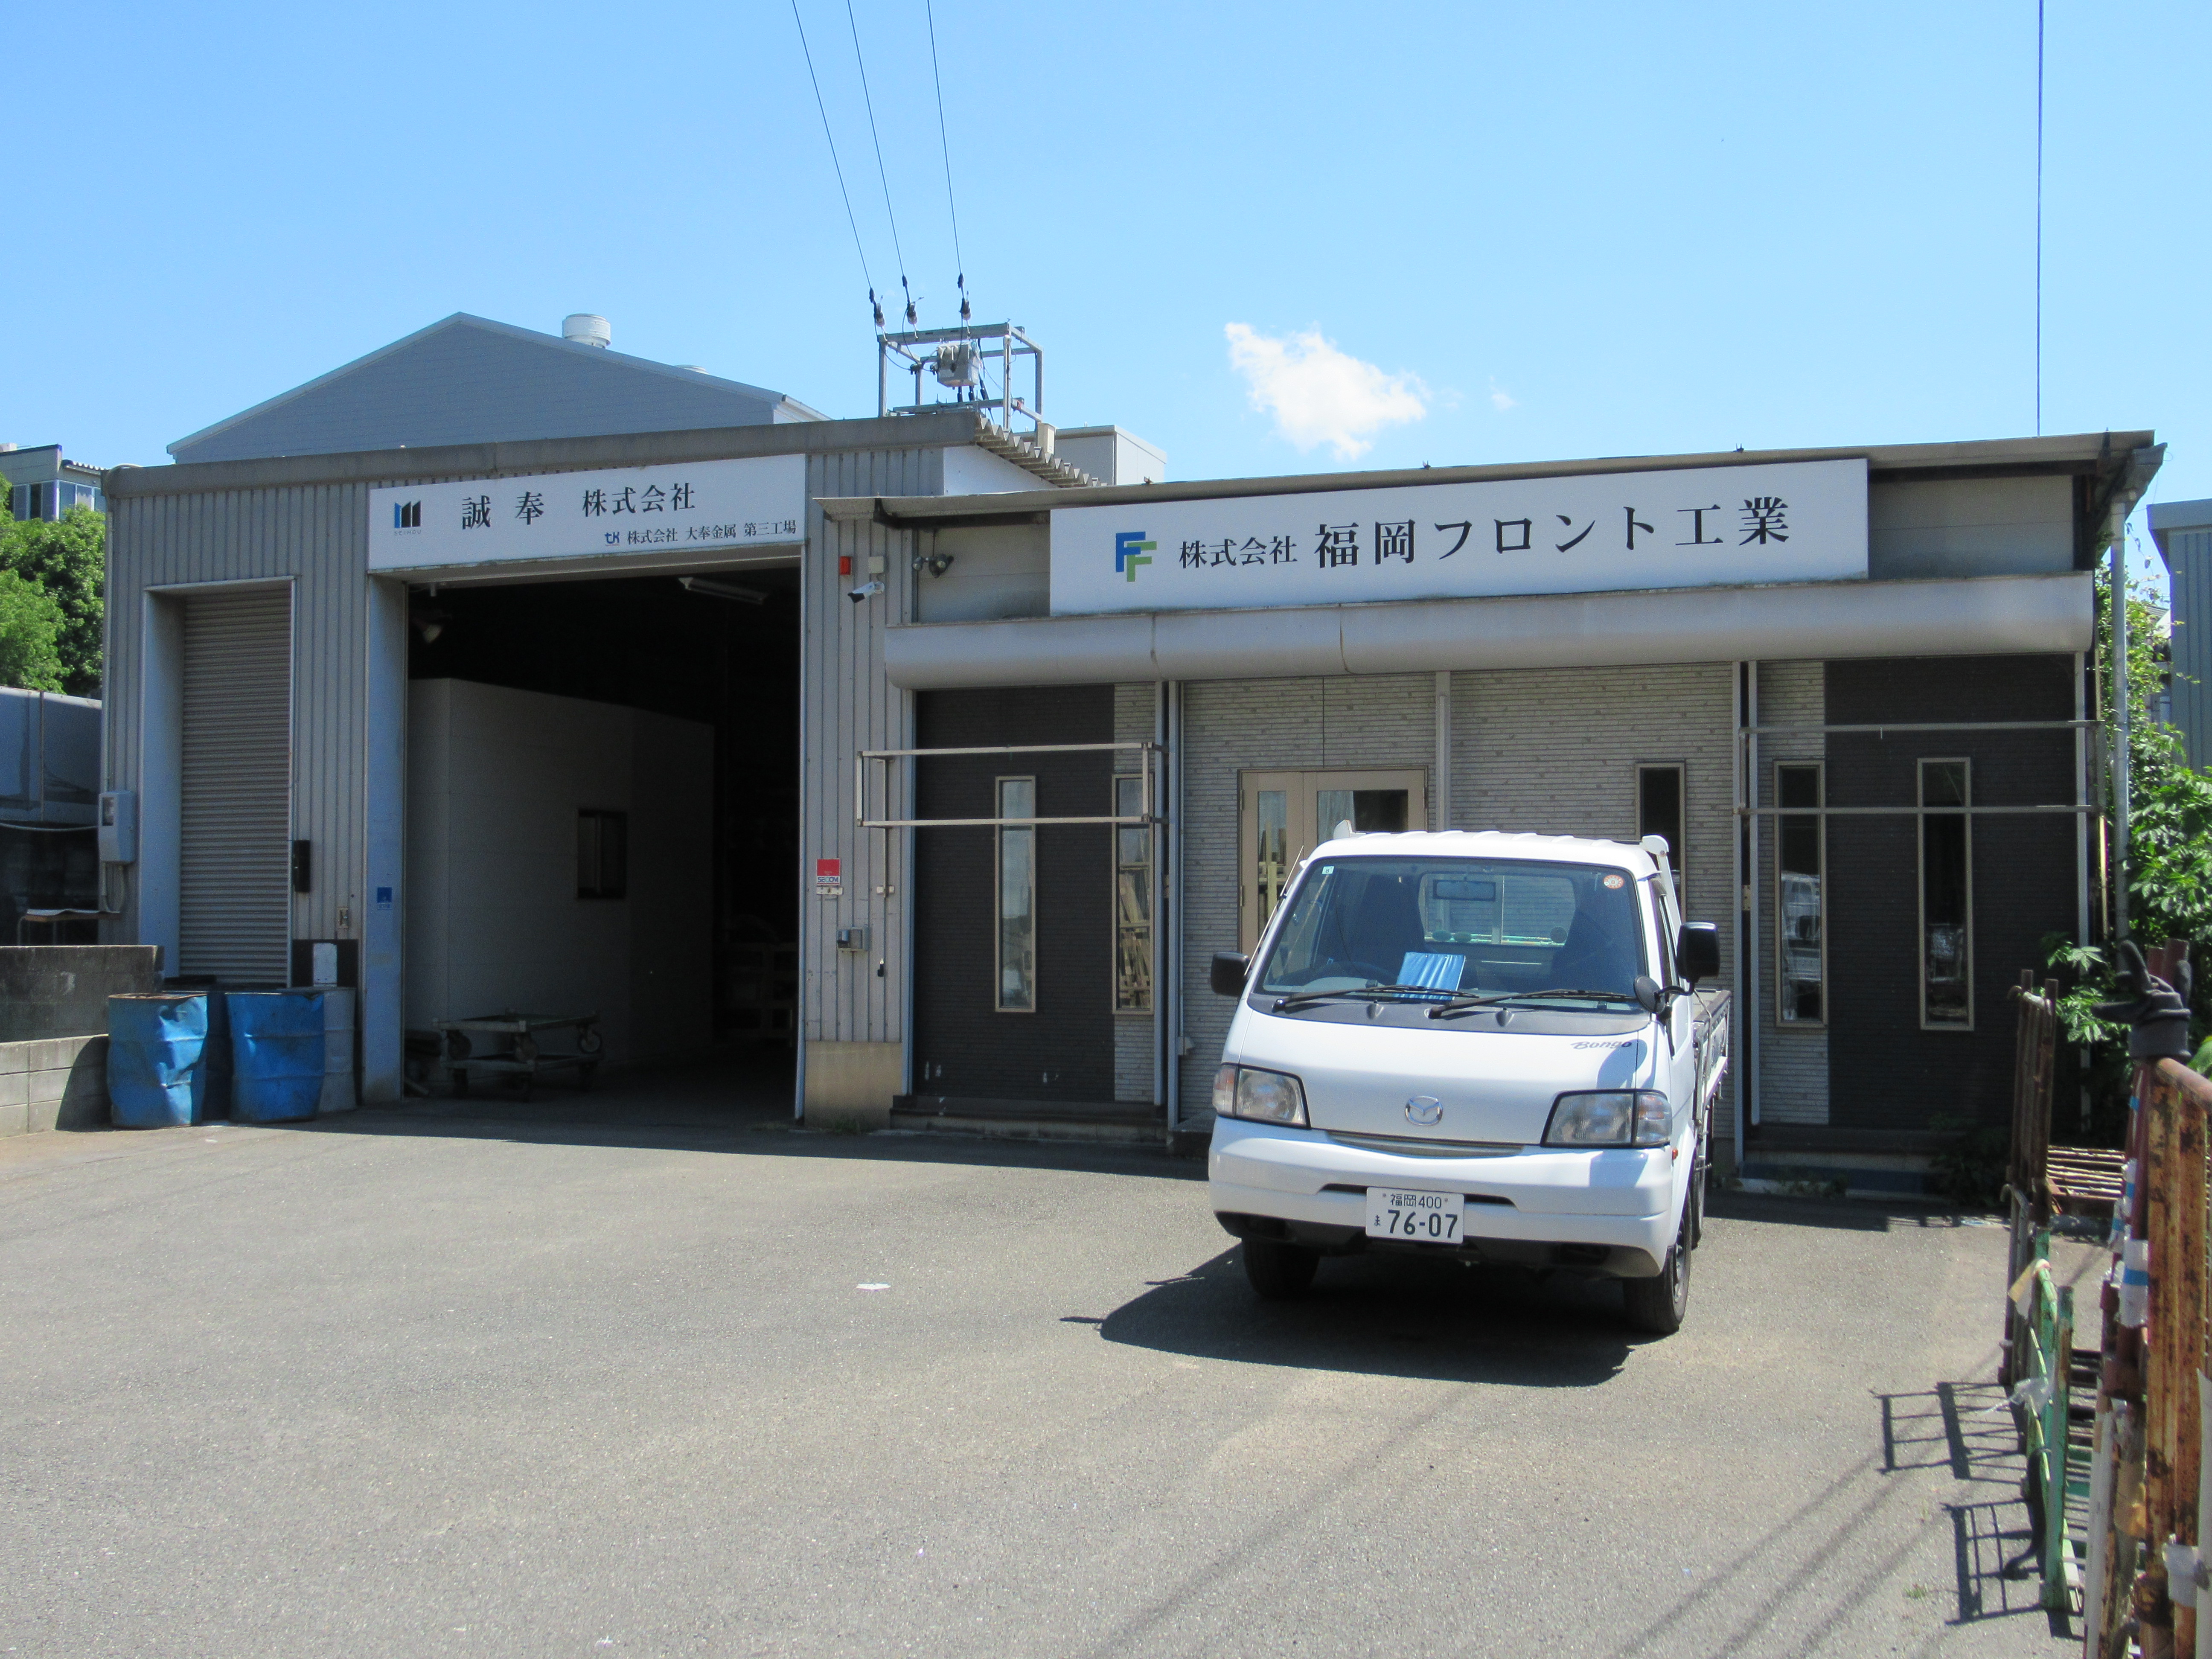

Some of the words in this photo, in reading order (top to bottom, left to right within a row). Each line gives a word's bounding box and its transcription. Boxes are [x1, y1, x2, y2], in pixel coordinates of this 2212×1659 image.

[582, 482, 696, 517] 株式会社
[628, 528, 678, 544] 株式会社
[686, 524, 736, 541] 大奉金属
[744, 519, 797, 537] 第三工場
[1179, 535, 1298, 569] 株式会社
[1314, 497, 1790, 569] 福岡フロント工業
[1571, 1041, 1632, 1049] Bongo
[1374, 1215, 1381, 1226] ま
[1388, 1209, 1458, 1238] 76-07
